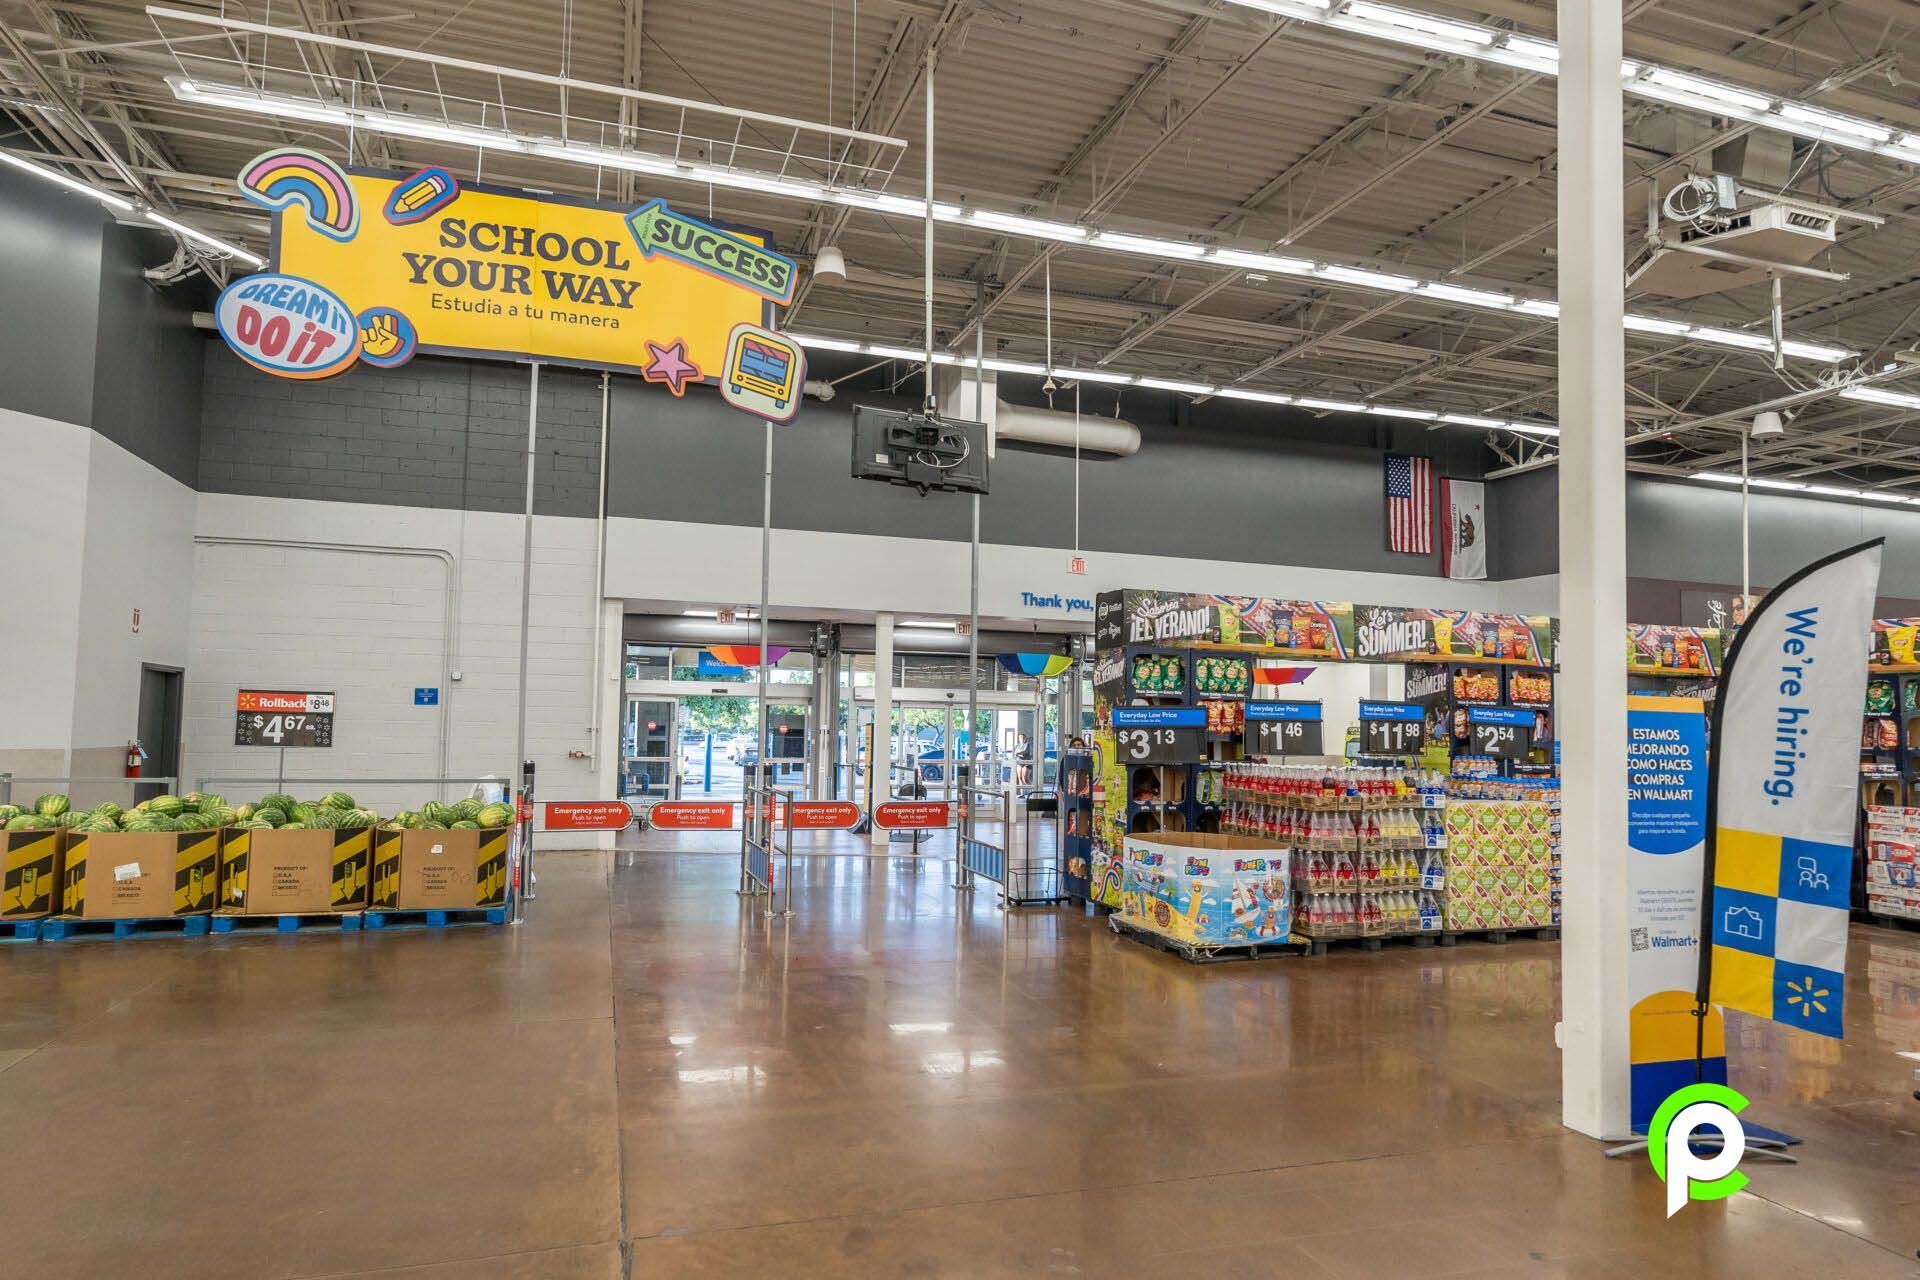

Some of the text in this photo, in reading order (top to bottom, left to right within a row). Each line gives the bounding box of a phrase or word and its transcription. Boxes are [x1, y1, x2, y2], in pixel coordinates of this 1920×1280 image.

[440, 218, 630, 271] SCHOOL
[652, 219, 787, 288] SUCCESS
[402, 252, 641, 309] YOUR WAY
[238, 283, 329, 324] DREAM
[431, 294, 620, 328] Estudia a tu manera
[237, 304, 290, 356] DO
[1072, 560, 1084, 572] EXIT
[1021, 592, 1062, 608] Thank
[1066, 598, 1094, 612] you,
[1137, 598, 1179, 618] Saborea
[721, 612, 736, 624] EXIT
[1155, 606, 1210, 640] VERANO!
[1358, 620, 1426, 657] SUMMER!
[1406, 672, 1447, 699] SUMMER!
[260, 697, 306, 708] Rollback
[1764, 606, 1818, 806] We're hiring.
[1633, 728, 1680, 740] ESTAMOS
[1660, 759, 1693, 770] HACES
[1634, 774, 1685, 785] COMPRAS
[1643, 789, 1693, 800] WALMART
[554, 807, 592, 815] Emergency
[660, 806, 696, 814] Emergency
[1651, 936, 1698, 948] Walmart+
